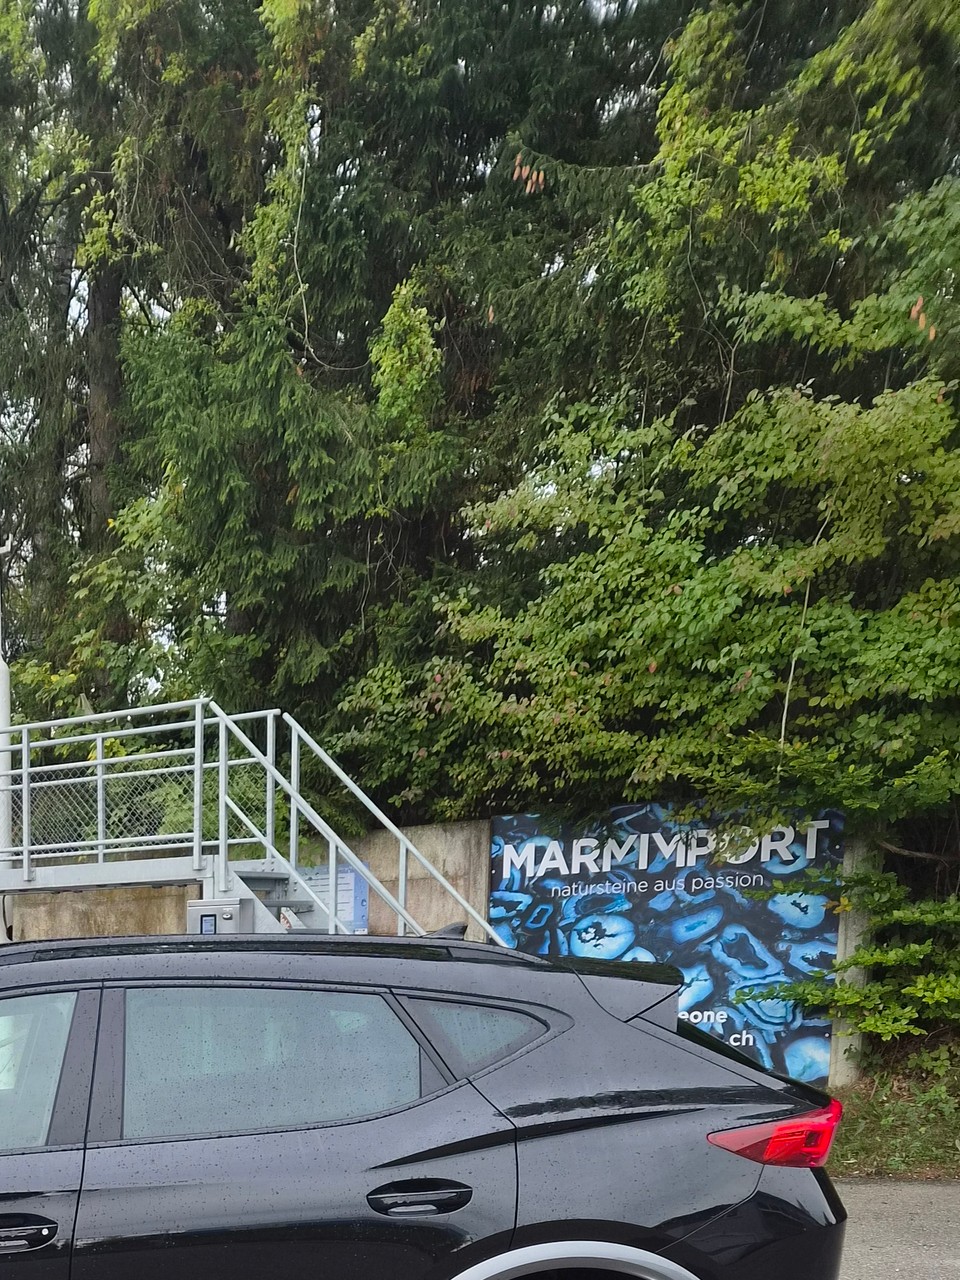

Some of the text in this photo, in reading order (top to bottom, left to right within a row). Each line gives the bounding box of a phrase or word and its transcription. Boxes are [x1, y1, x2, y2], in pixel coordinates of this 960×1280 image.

[551, 873, 764, 898] natursteine aus passion
